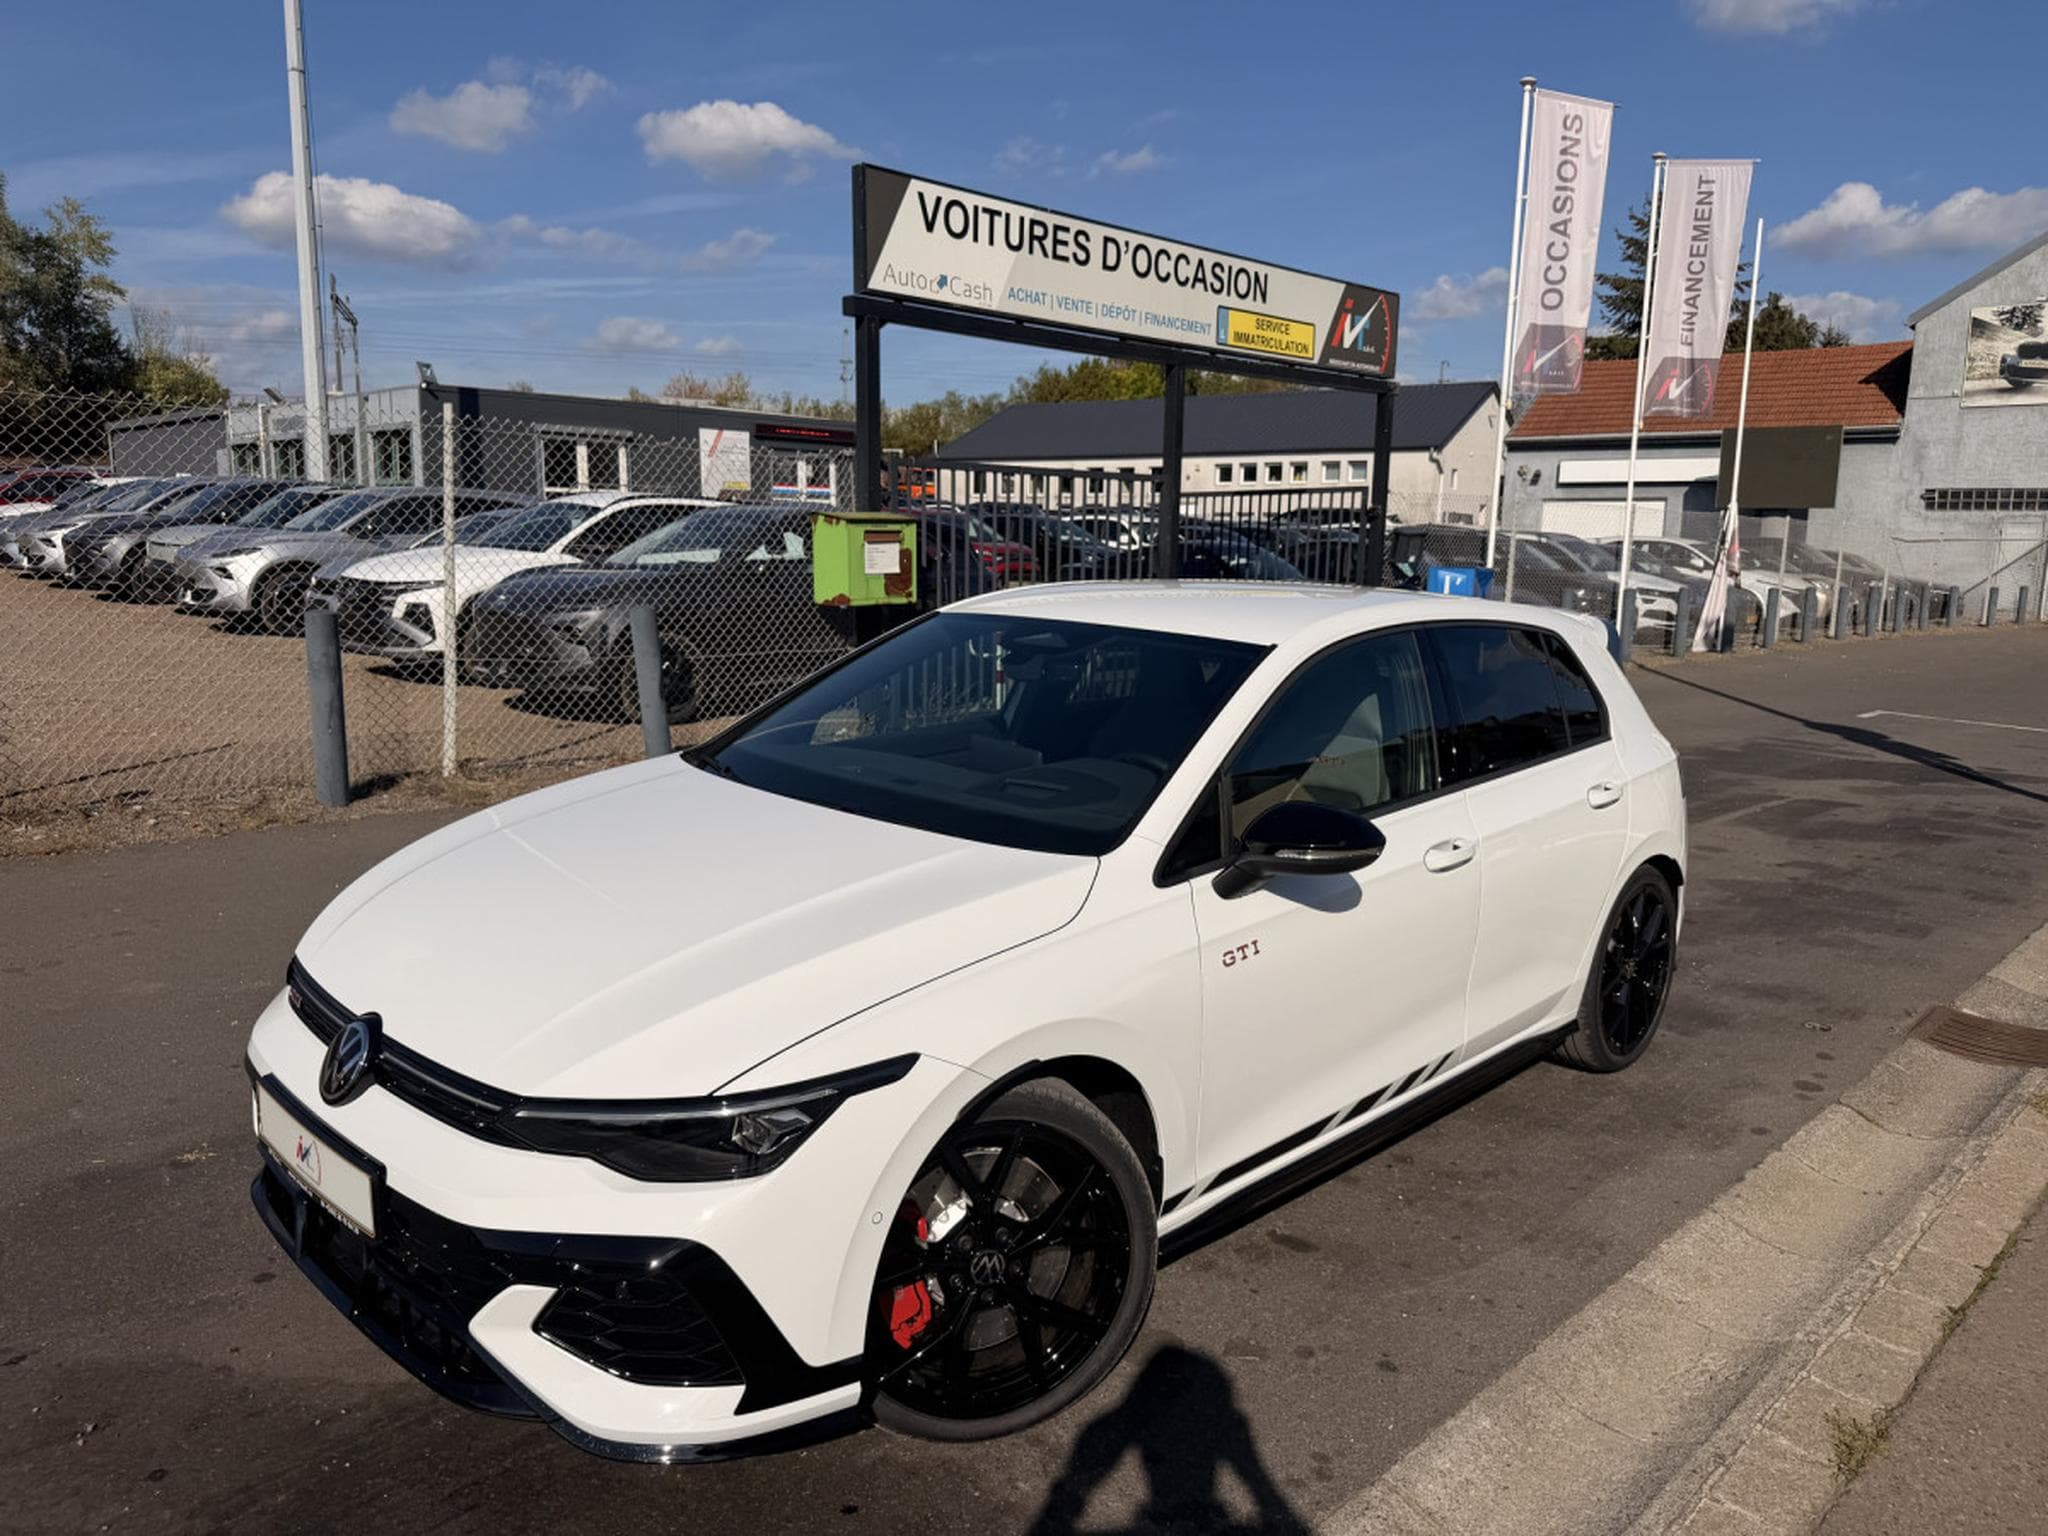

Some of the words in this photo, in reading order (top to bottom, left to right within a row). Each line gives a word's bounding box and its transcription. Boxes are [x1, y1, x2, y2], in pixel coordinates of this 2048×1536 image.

[1541, 112, 1584, 312] OCCASIONS
[917, 191, 1091, 267] VOITURES
[1102, 235, 1269, 305] D'OCCASION
[1680, 174, 1717, 347] FINANCEMENT
[882, 263, 928, 290] Auto
[949, 276, 993, 301] Cash
[1007, 287, 1047, 307] ACHAT
[1056, 295, 1093, 316] VENTE
[1101, 303, 1137, 323] DÉPÔT
[1144, 312, 1212, 336] FINANCEMENT
[1255, 317, 1291, 336] SERVICE
[1233, 332, 1310, 354] IMMATRICULATION
[1221, 939, 1261, 968] GTI
